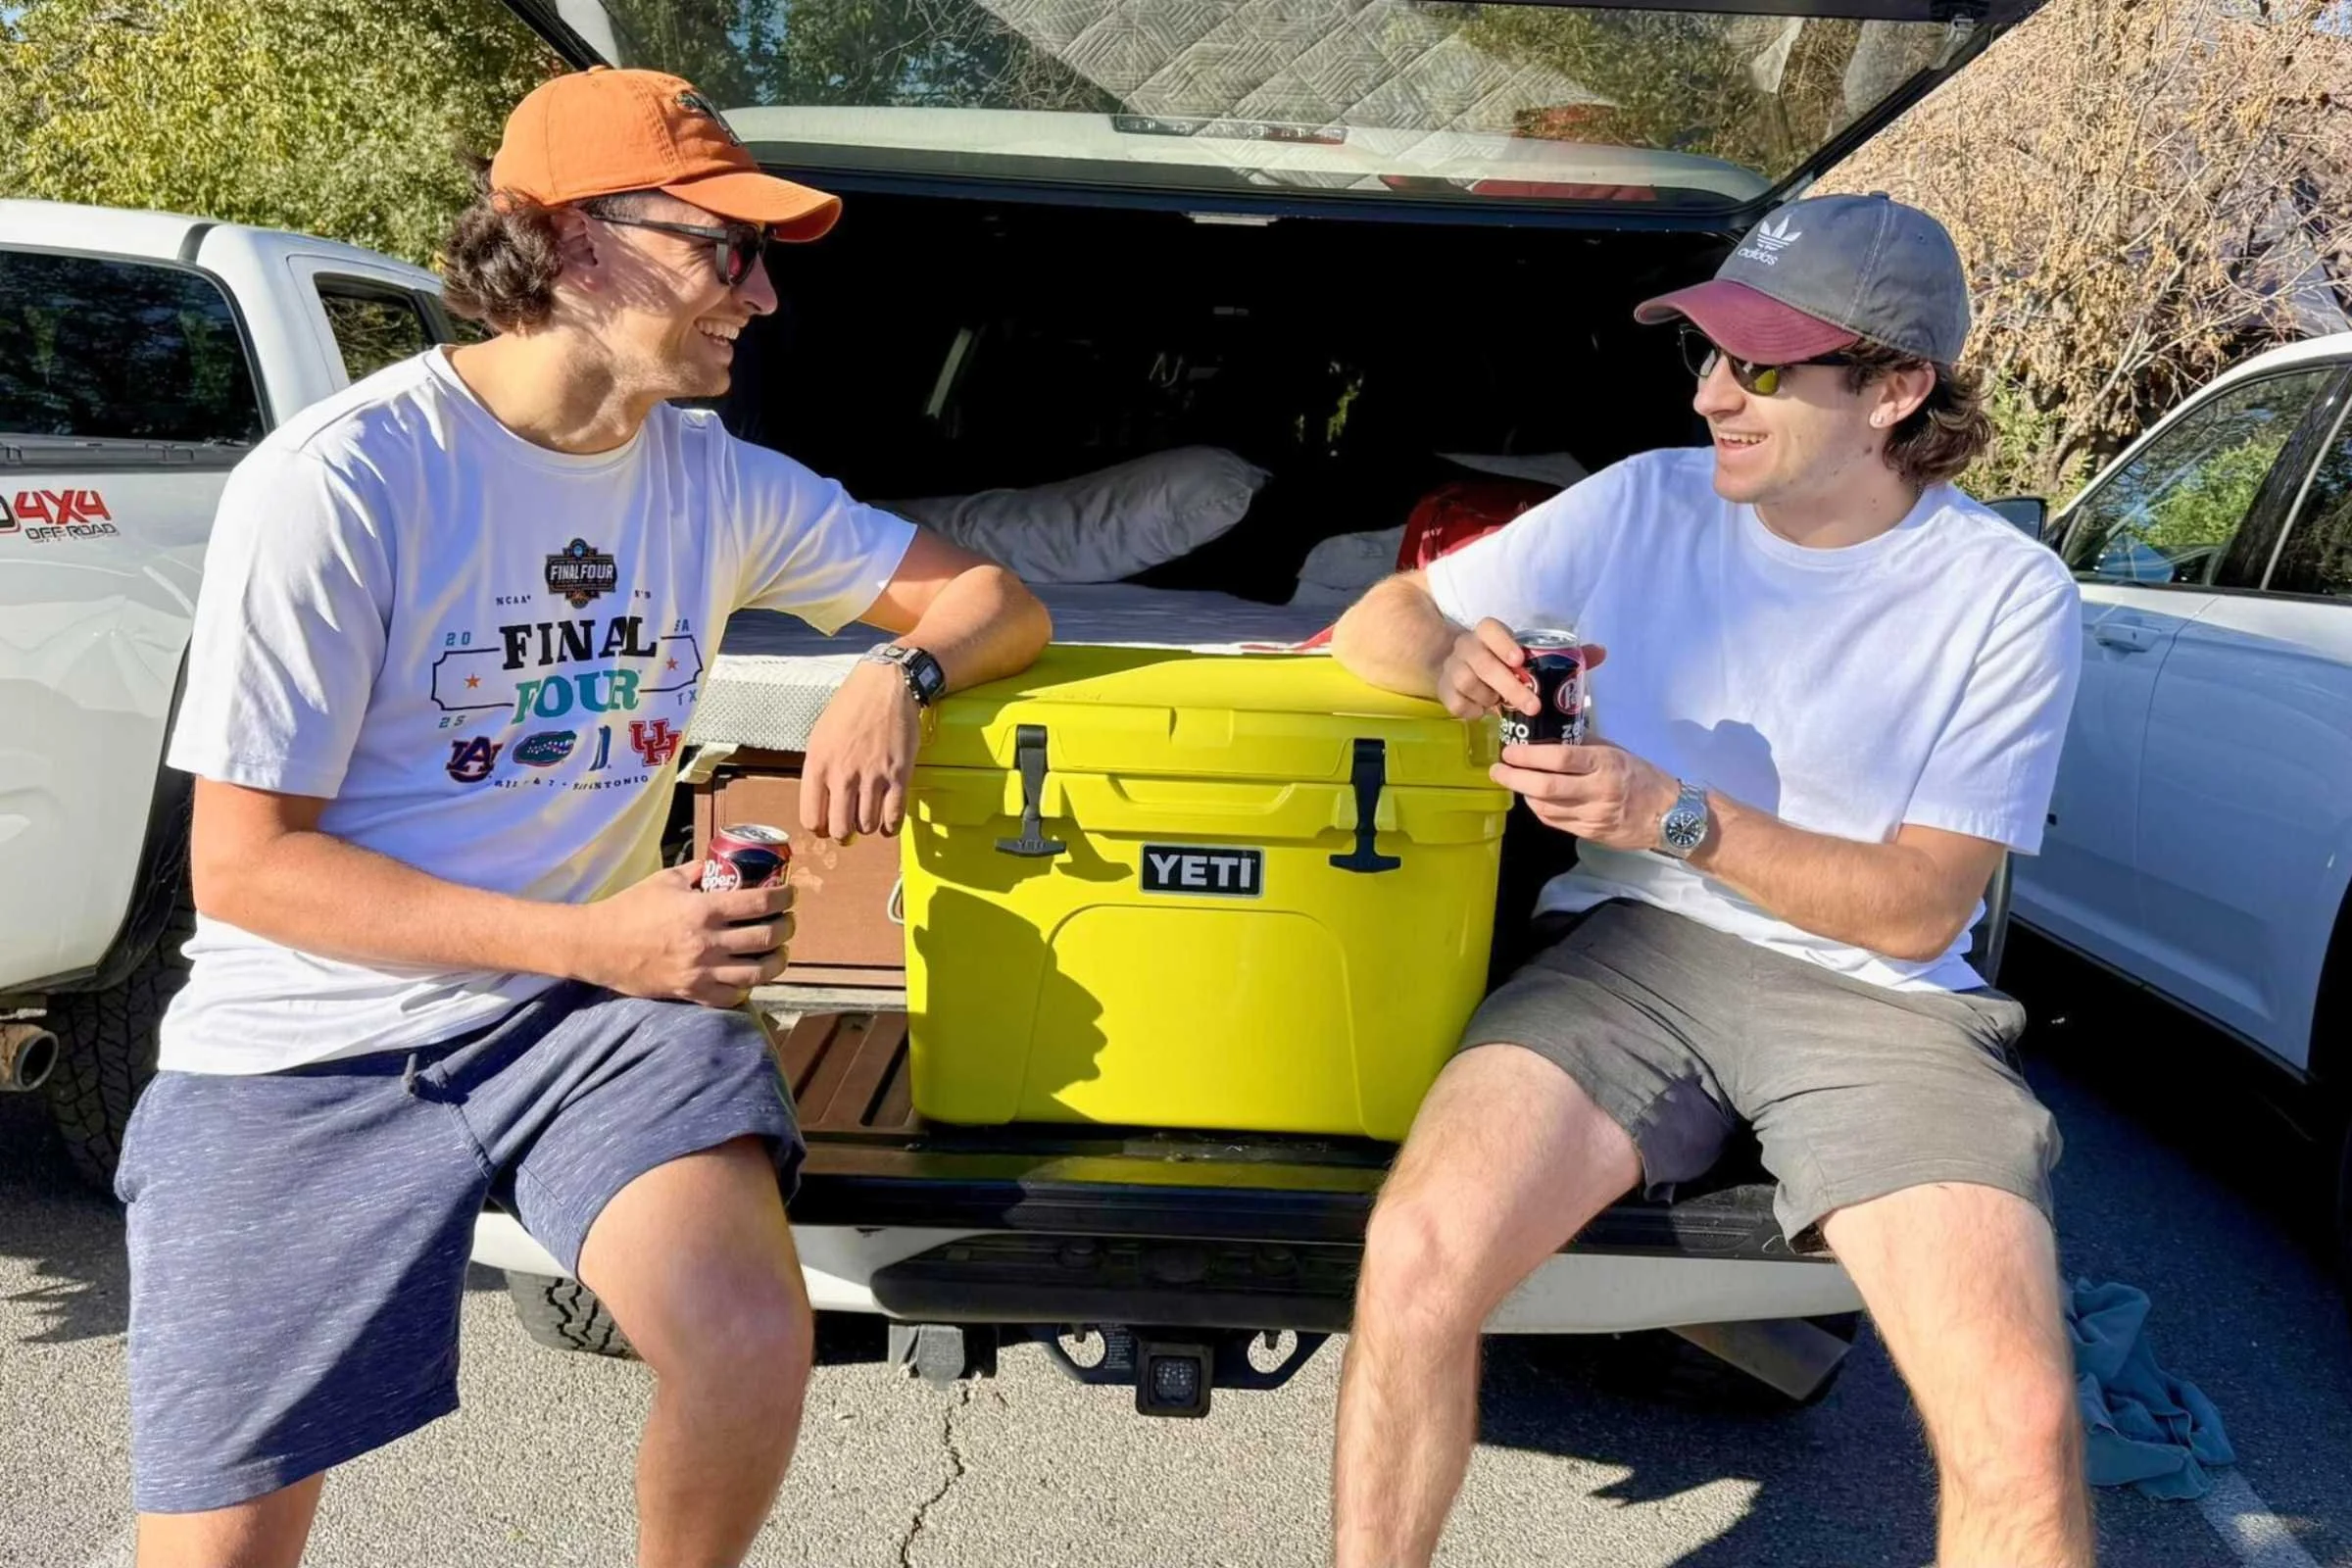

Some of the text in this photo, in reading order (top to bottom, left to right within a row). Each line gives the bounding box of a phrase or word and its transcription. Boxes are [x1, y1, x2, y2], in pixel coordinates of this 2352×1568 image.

[1738, 248, 1779, 267] adidas
[25, 523, 118, 540] OFF ROAD
[446, 632, 470, 646] 20
[499, 616, 658, 670] FINAL
[511, 668, 640, 725] FOUR
[705, 859, 722, 877] Dr
[1149, 854, 1252, 888] YETI
